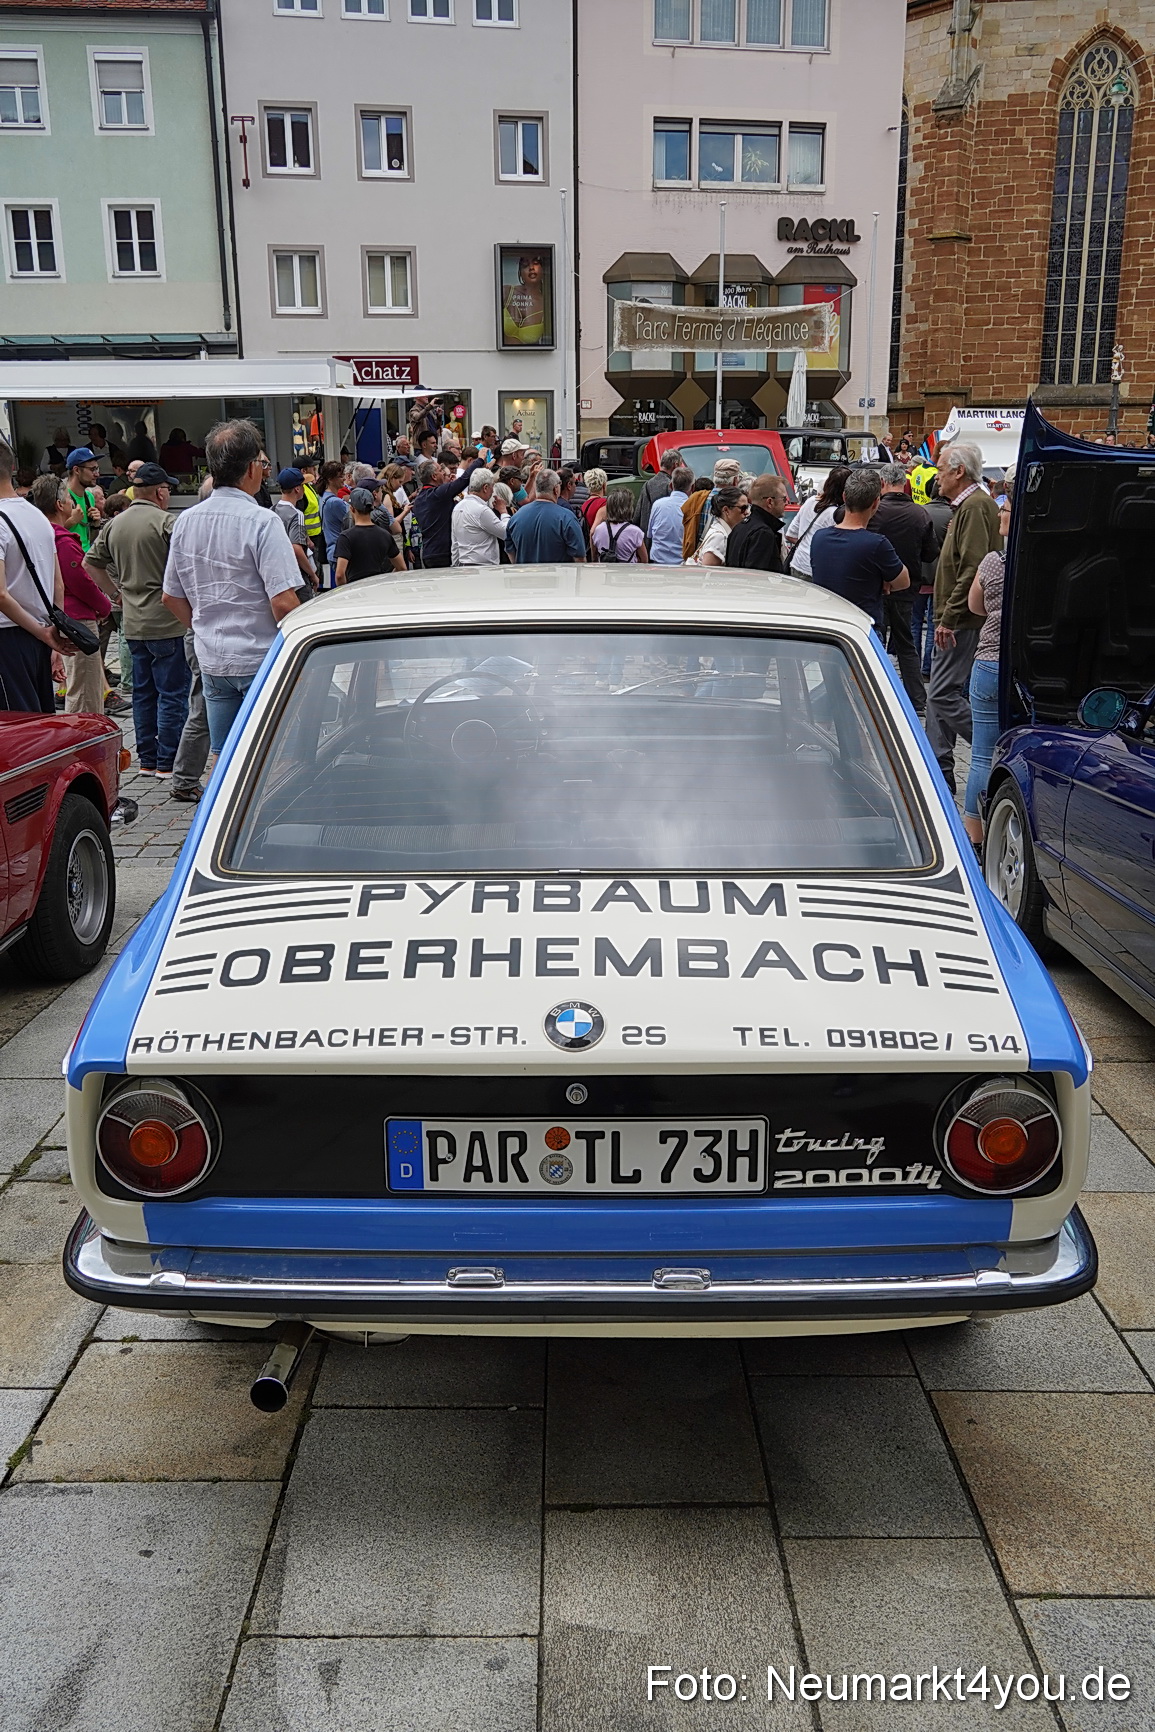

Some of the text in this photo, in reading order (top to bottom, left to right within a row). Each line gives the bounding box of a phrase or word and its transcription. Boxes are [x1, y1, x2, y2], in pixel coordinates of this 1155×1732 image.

[777, 217, 861, 242] RACKL
[787, 241, 851, 255] am Rathaus
[722, 295, 747, 308] RACKL
[636, 312, 668, 340] Parc
[673, 314, 723, 341] Fermé
[638, 412, 656, 421] RACKL
[957, 410, 998, 419] MARTINI
[356, 881, 788, 918] PYRBAUM
[219, 937, 930, 988] OBERHEMBACH
[550, 1002, 600, 1017] BMW
[131, 1025, 527, 1055] RÖTHENBACHER-STR.
[733, 1027, 810, 1048] TEL.
[426, 1129, 529, 1183] PAR
[575, 1130, 642, 1184] TL
[658, 1129, 759, 1184] 73H
[774, 1127, 886, 1166] touring
[400, 1162, 413, 1179] D
